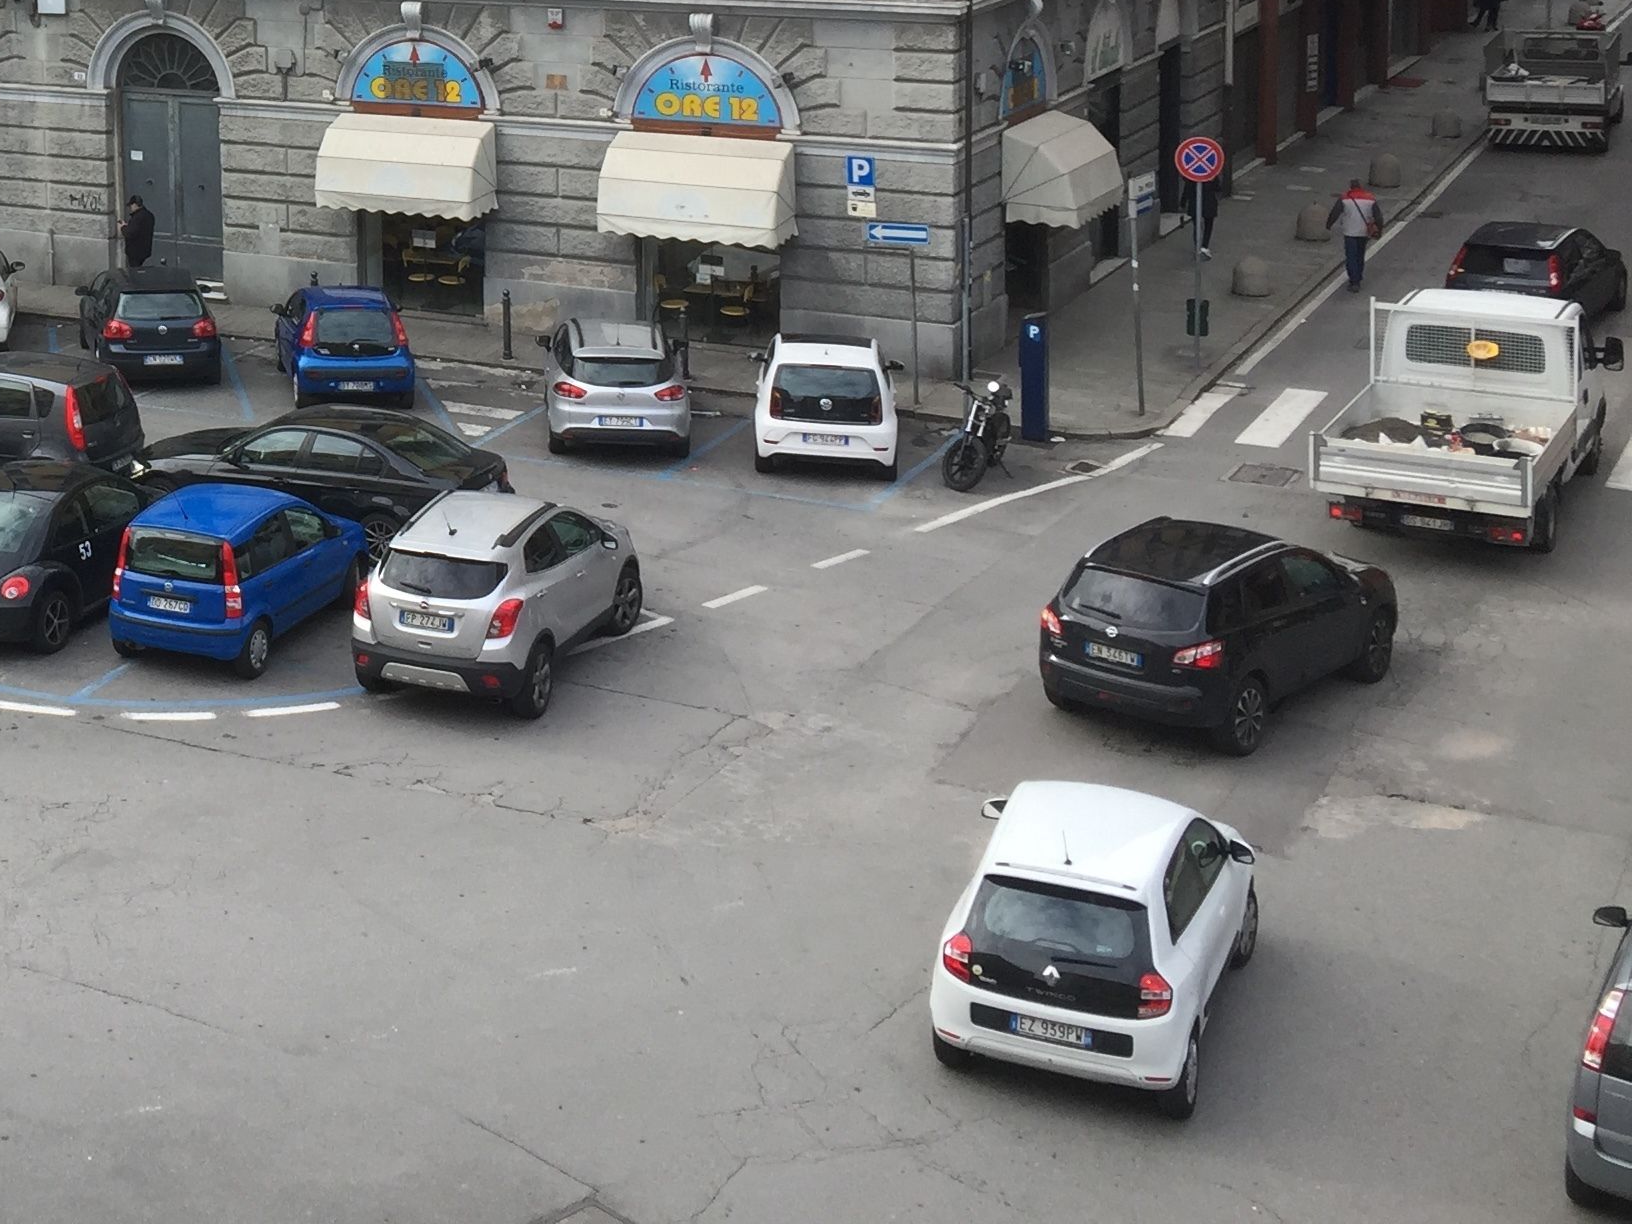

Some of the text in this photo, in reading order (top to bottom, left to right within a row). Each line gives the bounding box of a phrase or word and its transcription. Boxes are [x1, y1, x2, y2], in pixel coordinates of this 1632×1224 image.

[383, 64, 448, 79] Ristorante
[370, 76, 462, 104] ORE 12
[669, 78, 745, 94] Ristorante
[655, 92, 759, 121] ORE 12
[851, 159, 870, 183] P
[1029, 325, 1040, 338] P
[79, 541, 91, 561] 53
[1019, 1016, 1084, 1043] EZ 939PW
